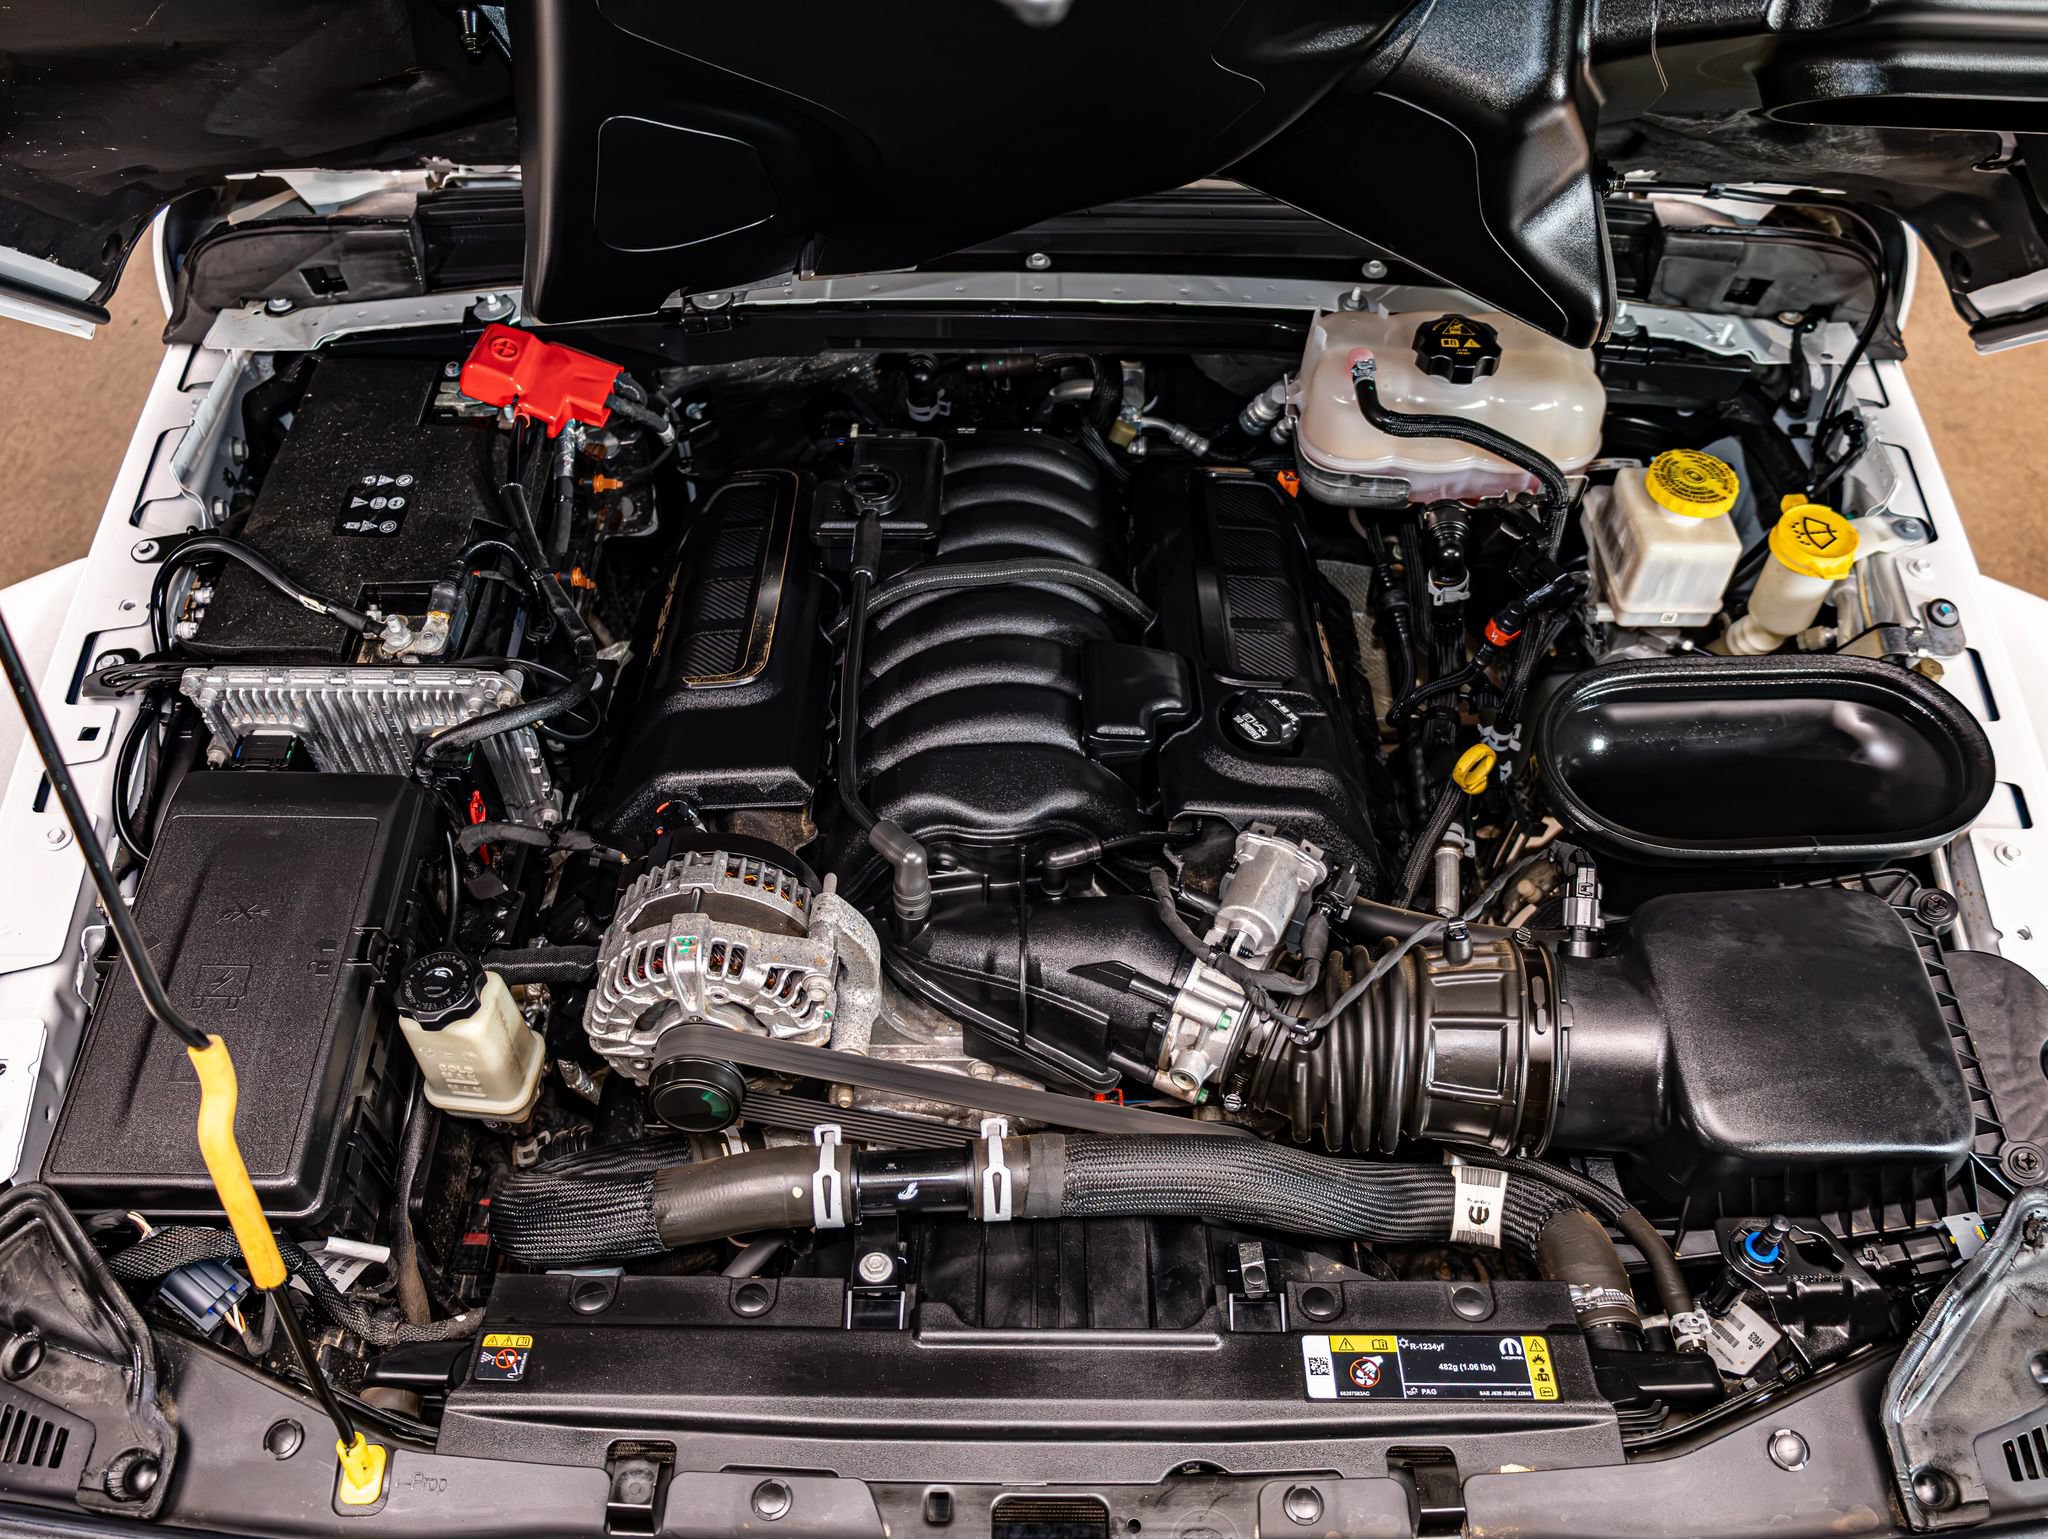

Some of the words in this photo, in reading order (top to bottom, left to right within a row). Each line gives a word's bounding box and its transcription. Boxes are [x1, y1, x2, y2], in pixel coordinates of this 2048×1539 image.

[1232, 714, 1244, 724] OIL
[1240, 721, 1262, 740] ENGINE
[438, 1063, 474, 1074] COLD
[1410, 1343, 1445, 1352] R-1234yf
[1438, 1363, 1458, 1372] 482g
[1459, 1363, 1479, 1372] (1.06
[1480, 1363, 1496, 1372] lbs)
[413, 1471, 448, 1496] Prop
